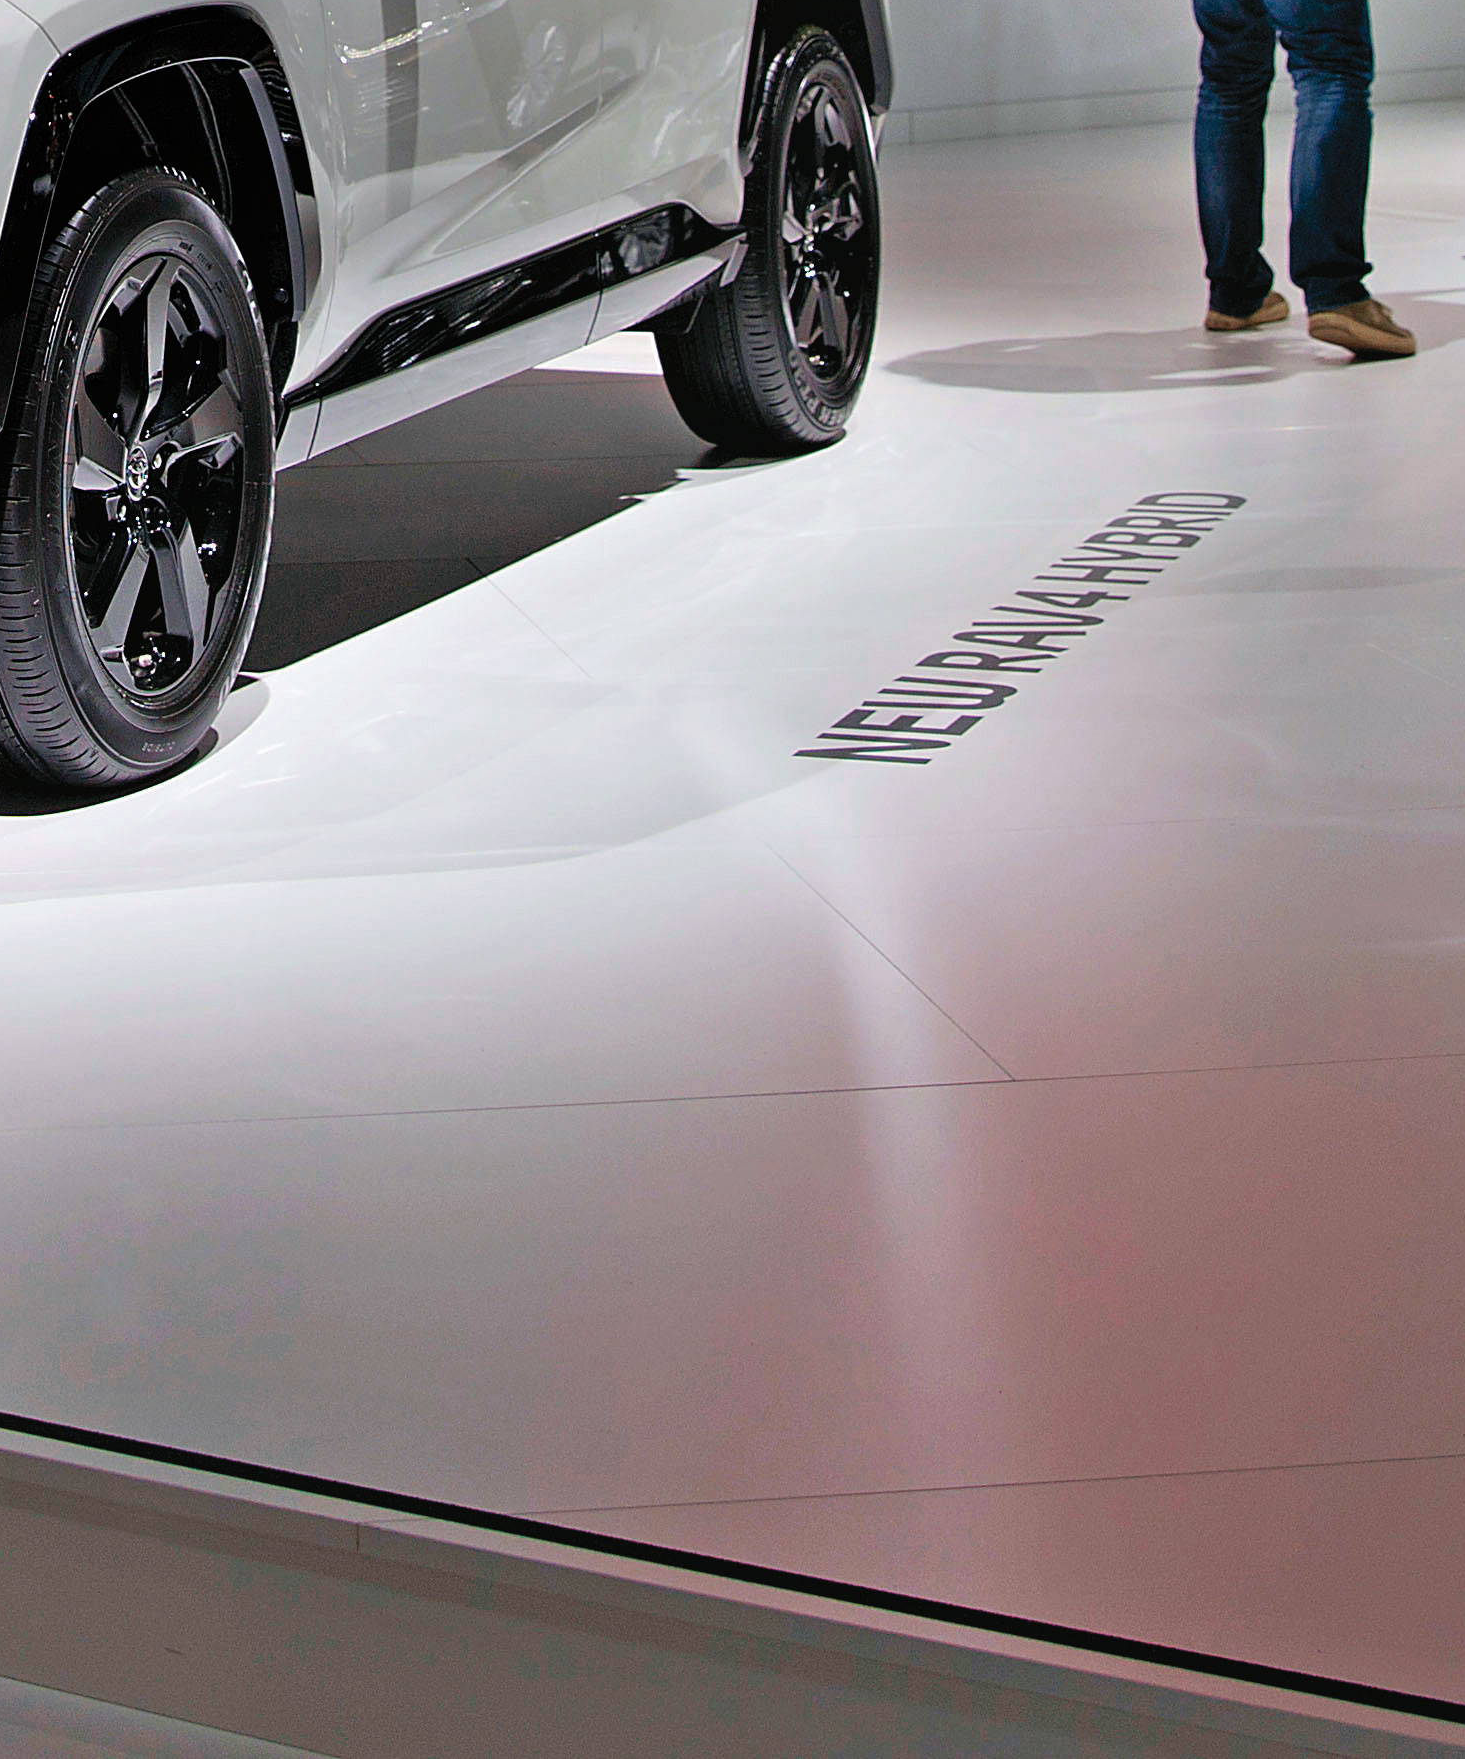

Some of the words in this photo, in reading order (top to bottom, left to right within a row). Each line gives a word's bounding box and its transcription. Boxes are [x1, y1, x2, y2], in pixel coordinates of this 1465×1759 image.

[792, 675, 1018, 765] NEW
[914, 590, 1131, 673] RAV4
[1033, 491, 1248, 585] HYBRID
